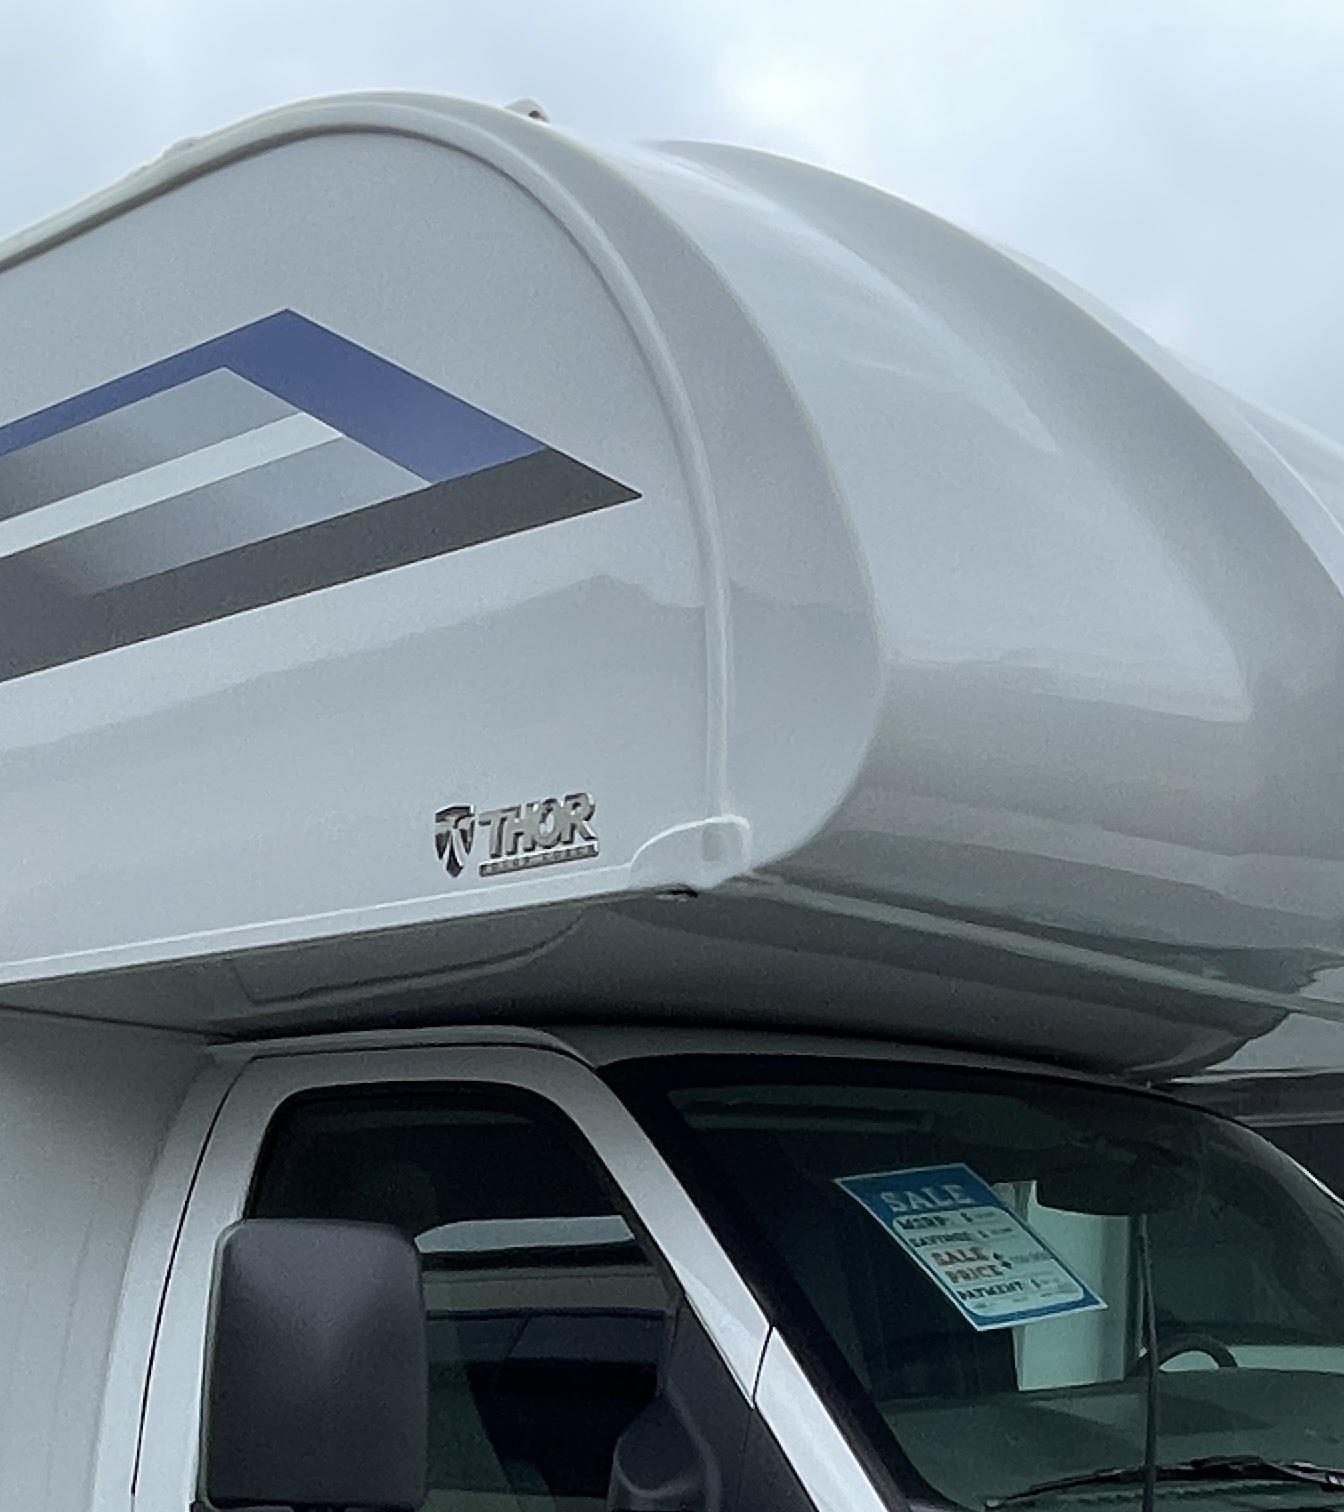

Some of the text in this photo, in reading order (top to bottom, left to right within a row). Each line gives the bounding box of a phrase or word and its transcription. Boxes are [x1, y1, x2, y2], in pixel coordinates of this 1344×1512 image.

[479, 793, 597, 859] THOR
[881, 1184, 975, 1212] SALE
[930, 1246, 990, 1266] SALE
[944, 1263, 1004, 1284] PRICE
